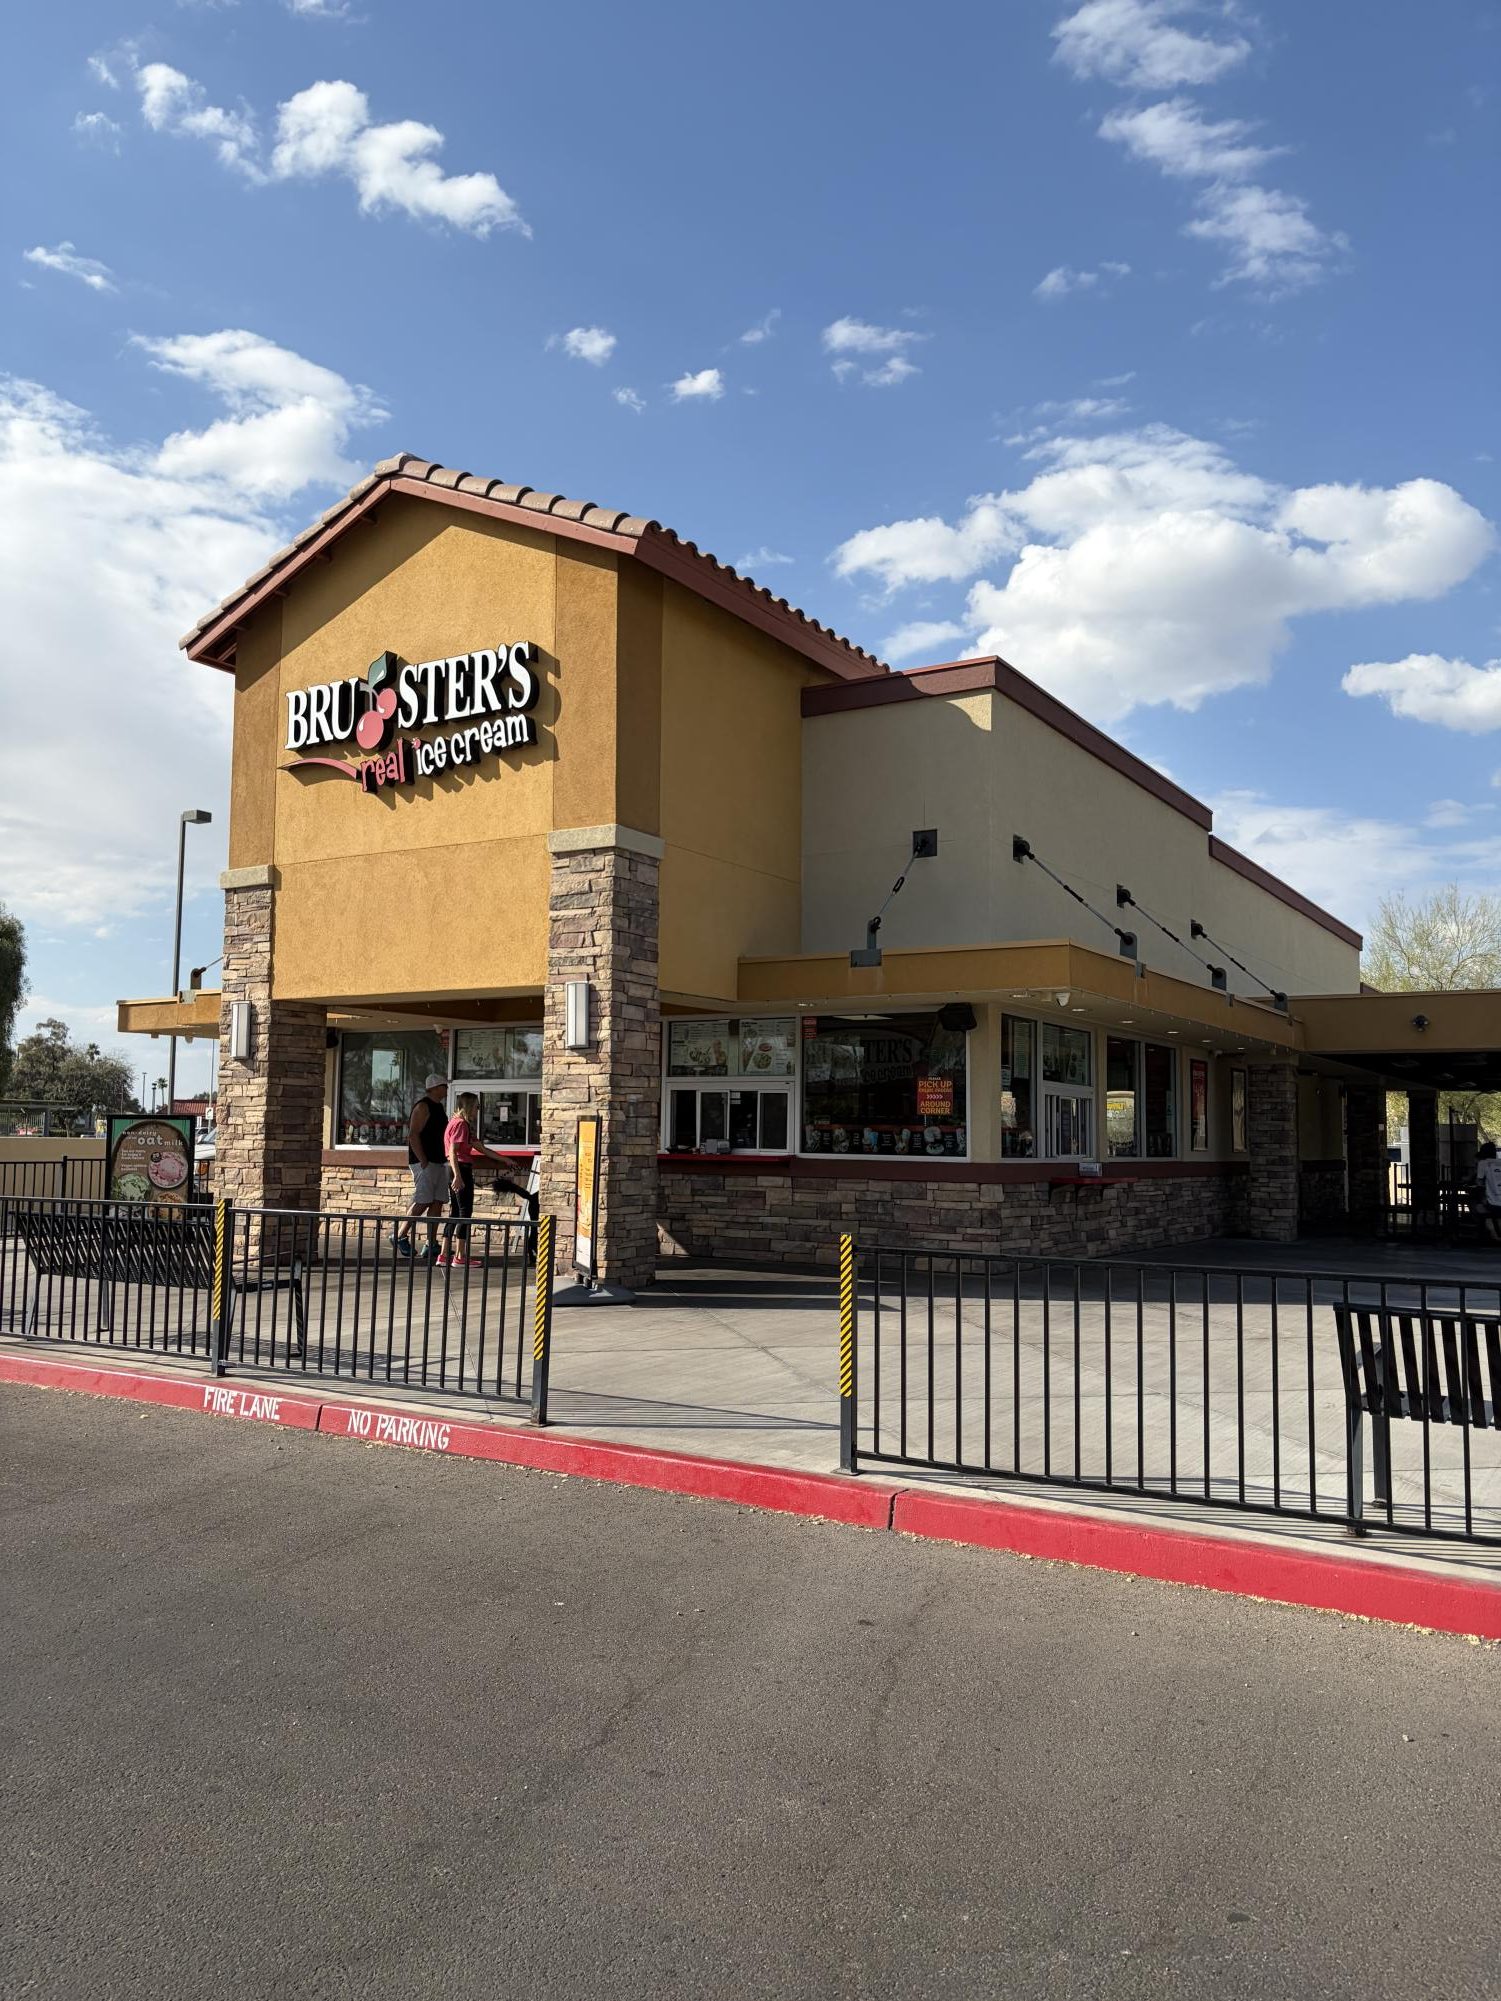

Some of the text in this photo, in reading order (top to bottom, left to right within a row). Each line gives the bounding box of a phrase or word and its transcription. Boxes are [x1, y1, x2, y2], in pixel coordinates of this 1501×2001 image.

[360, 713, 530, 792] real ice cream
[918, 1080, 953, 1088] PICK UP
[137, 1135, 163, 1146] oat
[203, 1386, 280, 1420] FIRE LANE
[347, 1409, 451, 1449] NO PARKING
